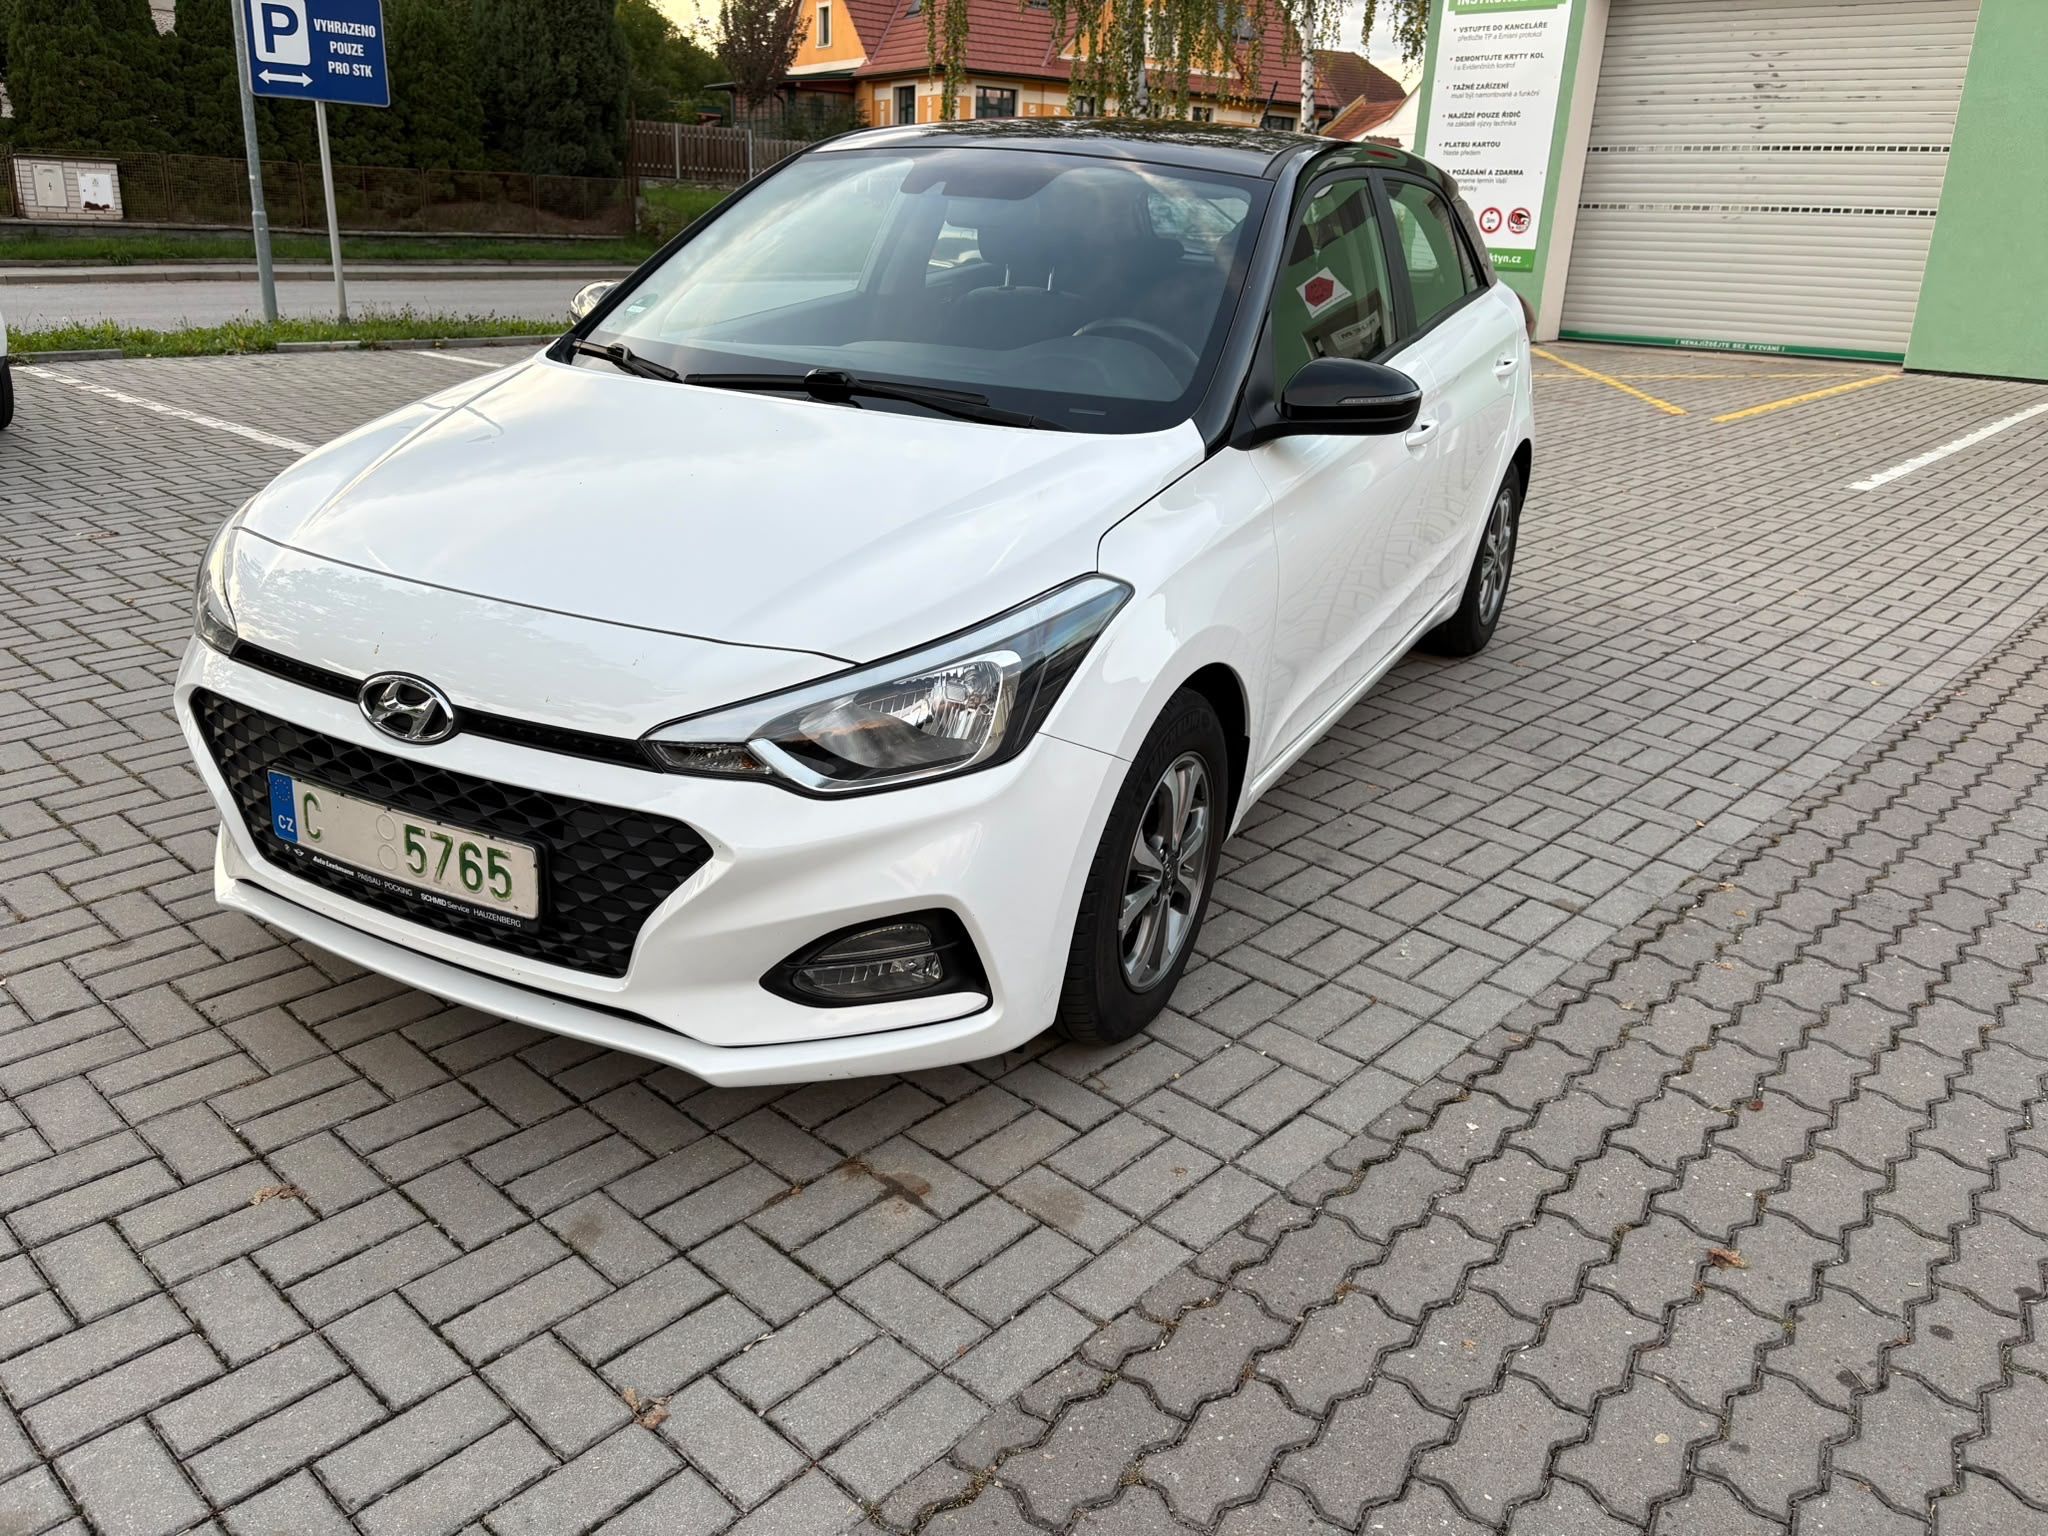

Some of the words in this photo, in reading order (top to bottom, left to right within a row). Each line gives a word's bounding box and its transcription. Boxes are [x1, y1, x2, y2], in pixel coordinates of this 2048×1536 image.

[261, 3, 299, 53] P
[313, 18, 376, 38] VYHRAZENO
[1459, 25, 1491, 33] VSTUPTE
[1504, 21, 1548, 30] KANCELÁŘE
[329, 41, 365, 57] POUZE
[1455, 54, 1502, 62] DEMONTUJTE
[328, 61, 350, 75] PRO
[352, 65, 373, 78] STK
[1452, 83, 1474, 91] TAŽNÉ
[1475, 82, 1509, 90] ZAŘÍZENÍ
[1447, 111, 1475, 119] NAJÍŽDÍ
[1501, 110, 1522, 118] ŘIDIČ
[1452, 168, 1487, 176] POŽÁDÁNÍ
[1489, 253, 1521, 265] ktyn.cz
[278, 814, 295, 833] CZ
[303, 791, 323, 842] C
[403, 823, 513, 902] 5765
[357, 872, 381, 886] PASSAU
[384, 881, 413, 897] POCKING
[420, 892, 447, 906] SCHMID
[447, 901, 470, 914] Service
[473, 908, 521, 928] HAUZENBERG
